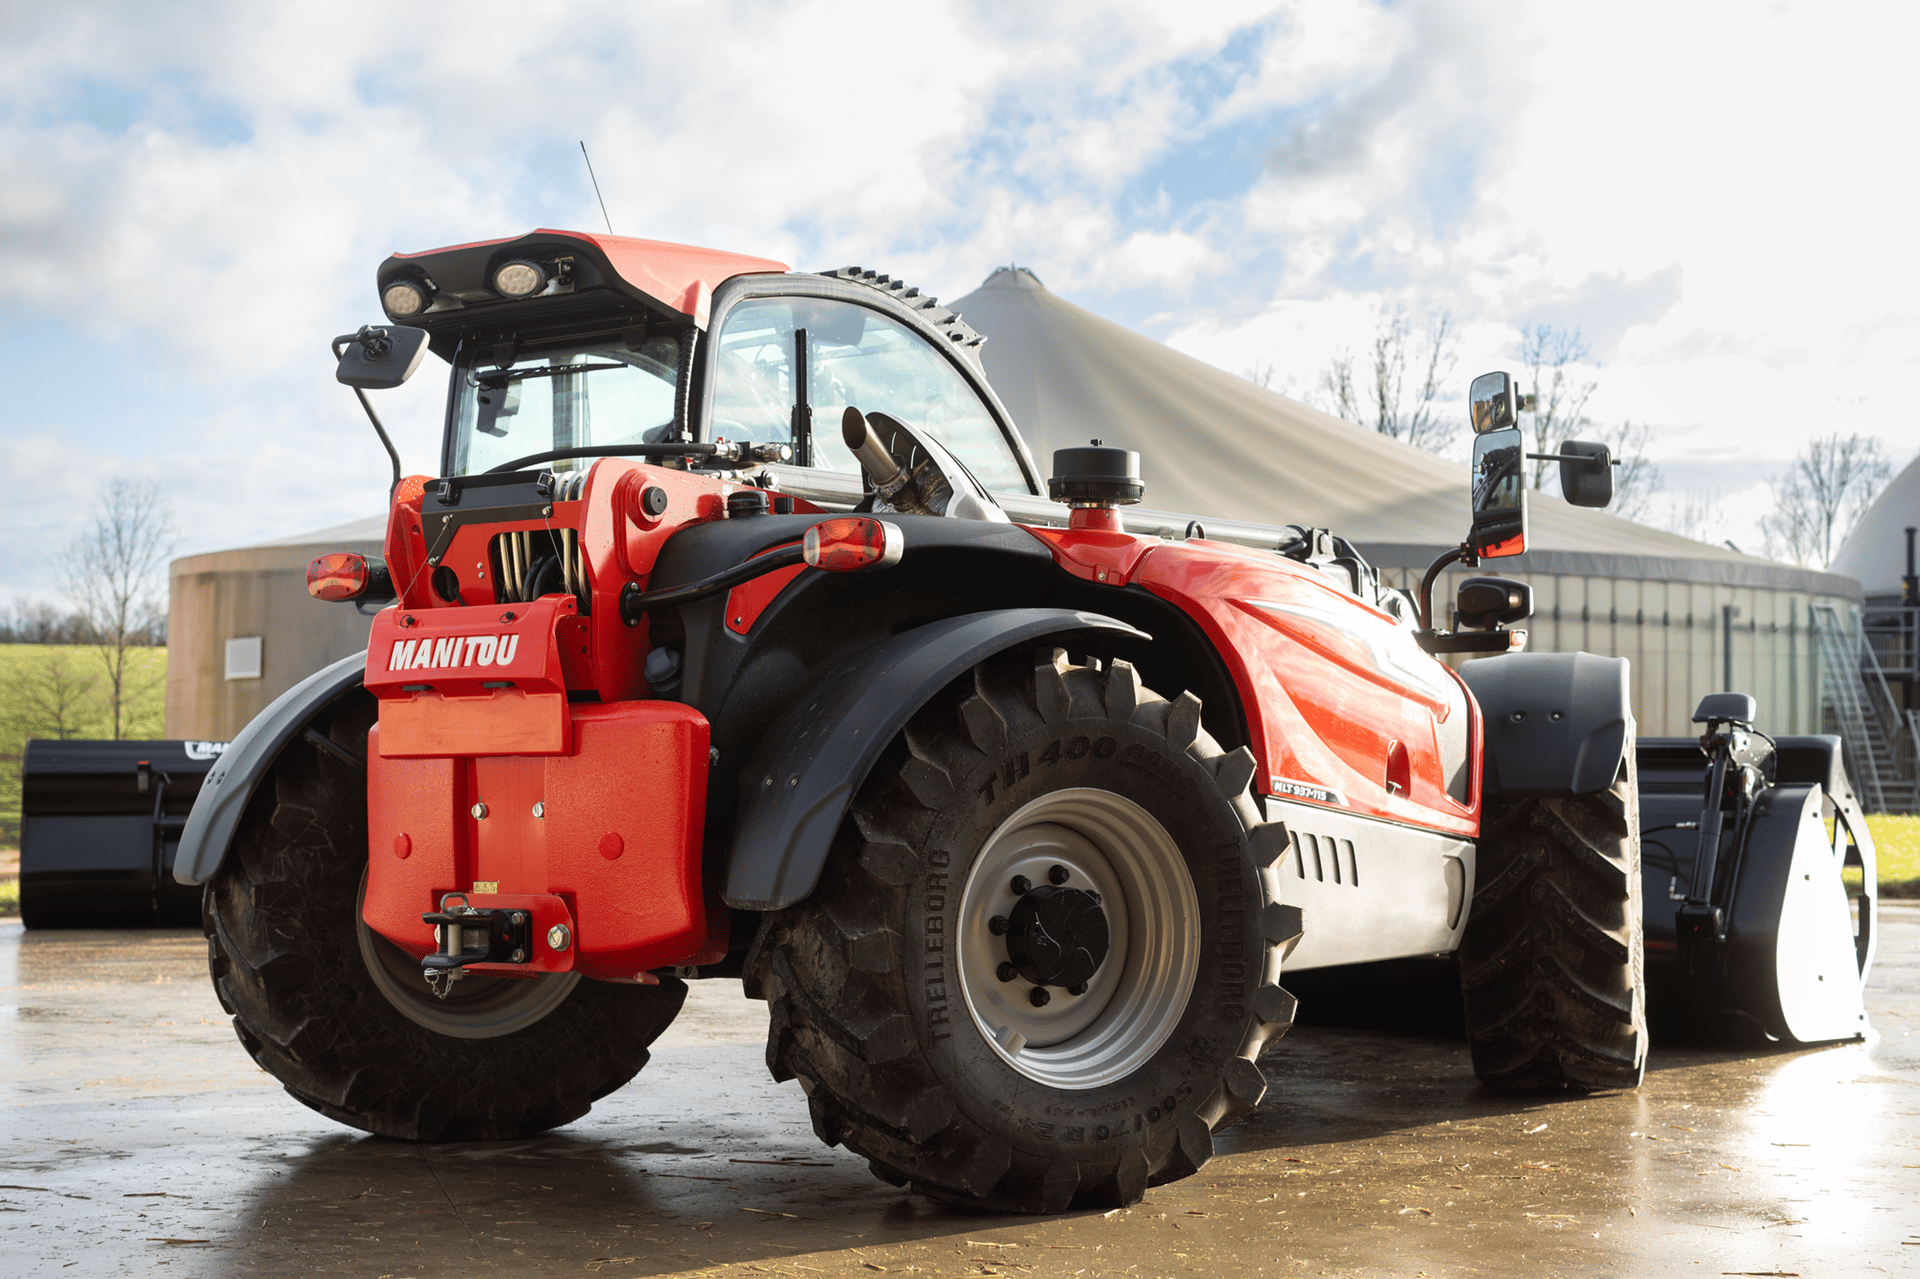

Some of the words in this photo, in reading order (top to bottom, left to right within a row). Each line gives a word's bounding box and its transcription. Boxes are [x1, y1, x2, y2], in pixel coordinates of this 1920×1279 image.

[388, 634, 519, 672] MANITOU
[975, 752, 1030, 806] TH
[1038, 735, 1117, 766] 400
[1122, 741, 1198, 794] AGRO
[1274, 781, 1293, 794] MLT
[1293, 785, 1327, 801] 937-115
[926, 848, 952, 1047] TRELLEBORG
[1217, 836, 1246, 1022] TRELLEBORG
[1091, 1080, 1194, 1143] 500/70
